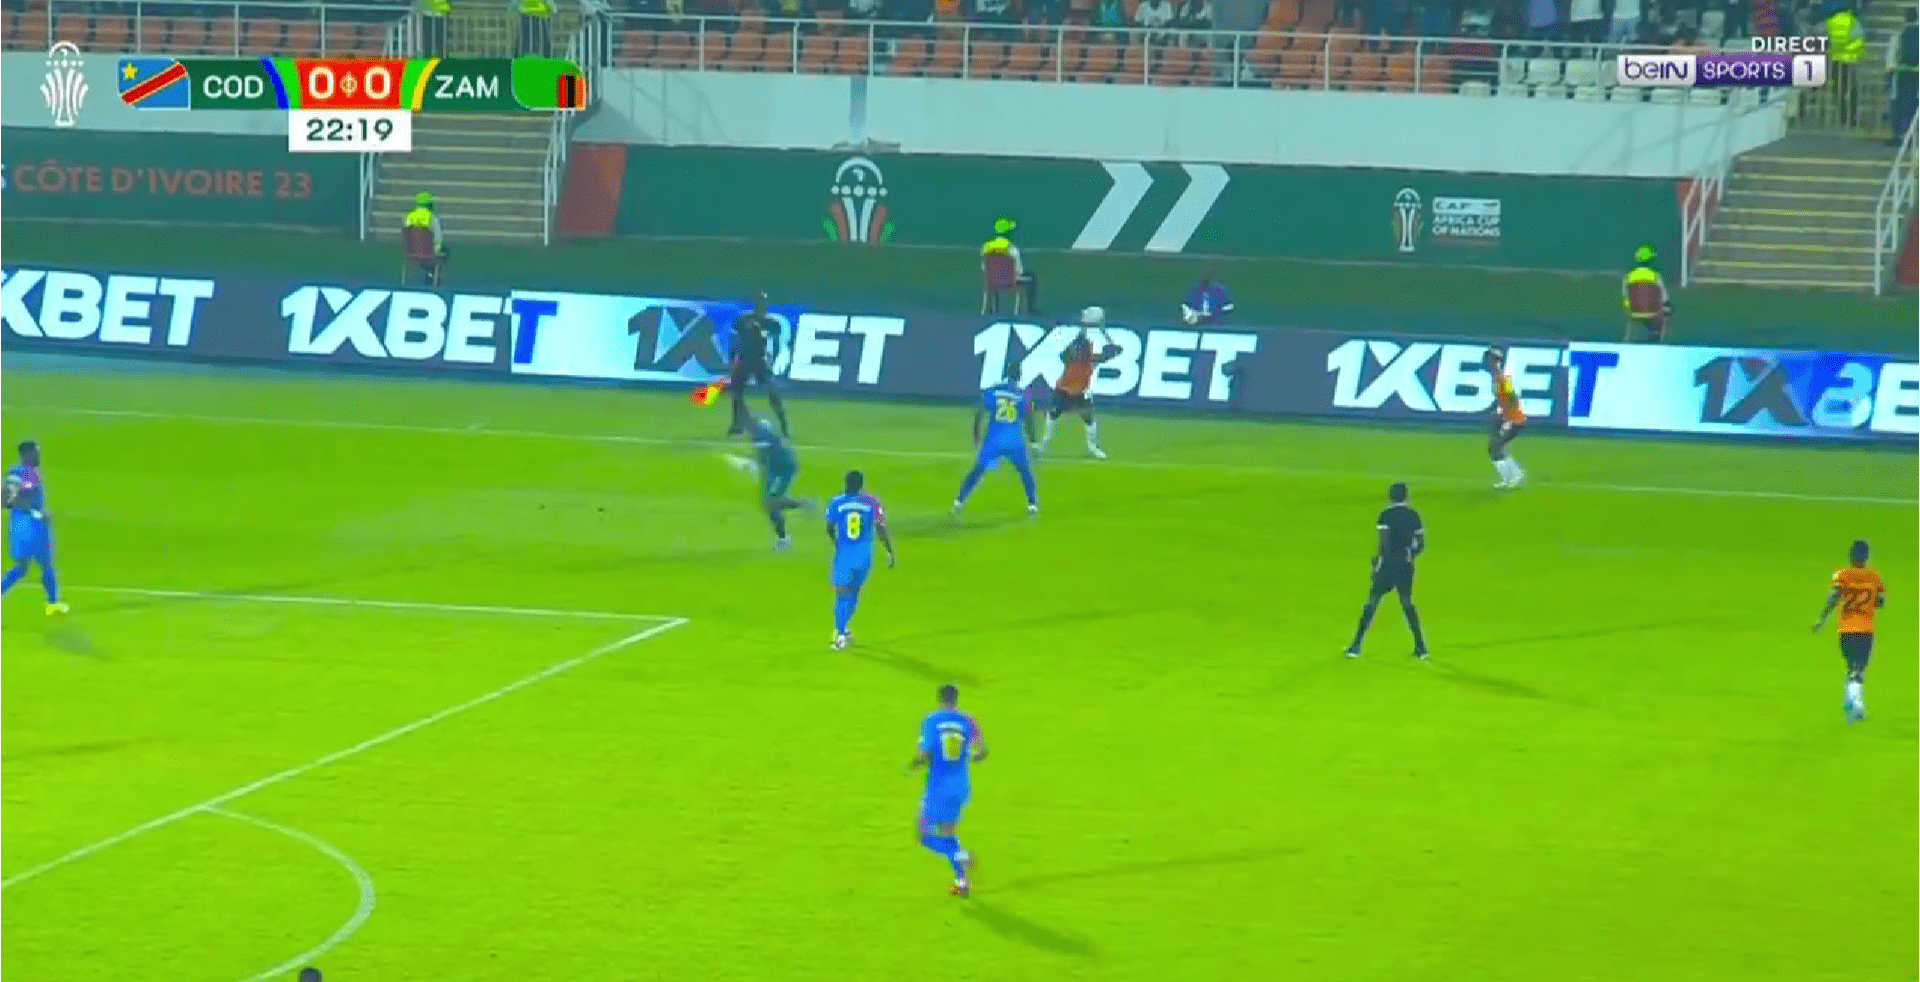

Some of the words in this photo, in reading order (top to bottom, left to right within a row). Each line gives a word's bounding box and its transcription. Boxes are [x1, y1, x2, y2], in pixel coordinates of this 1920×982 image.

[13, 158, 102, 193] CÔTE
[110, 167, 263, 196] D'IVOIRE
[274, 171, 313, 198] 23
[281, 286, 559, 364] 1XBET
[974, 321, 1258, 401] 1XBET
[1327, 339, 1620, 418] 1XBET
[847, 511, 861, 540] 8
[1841, 586, 1873, 615] 22
